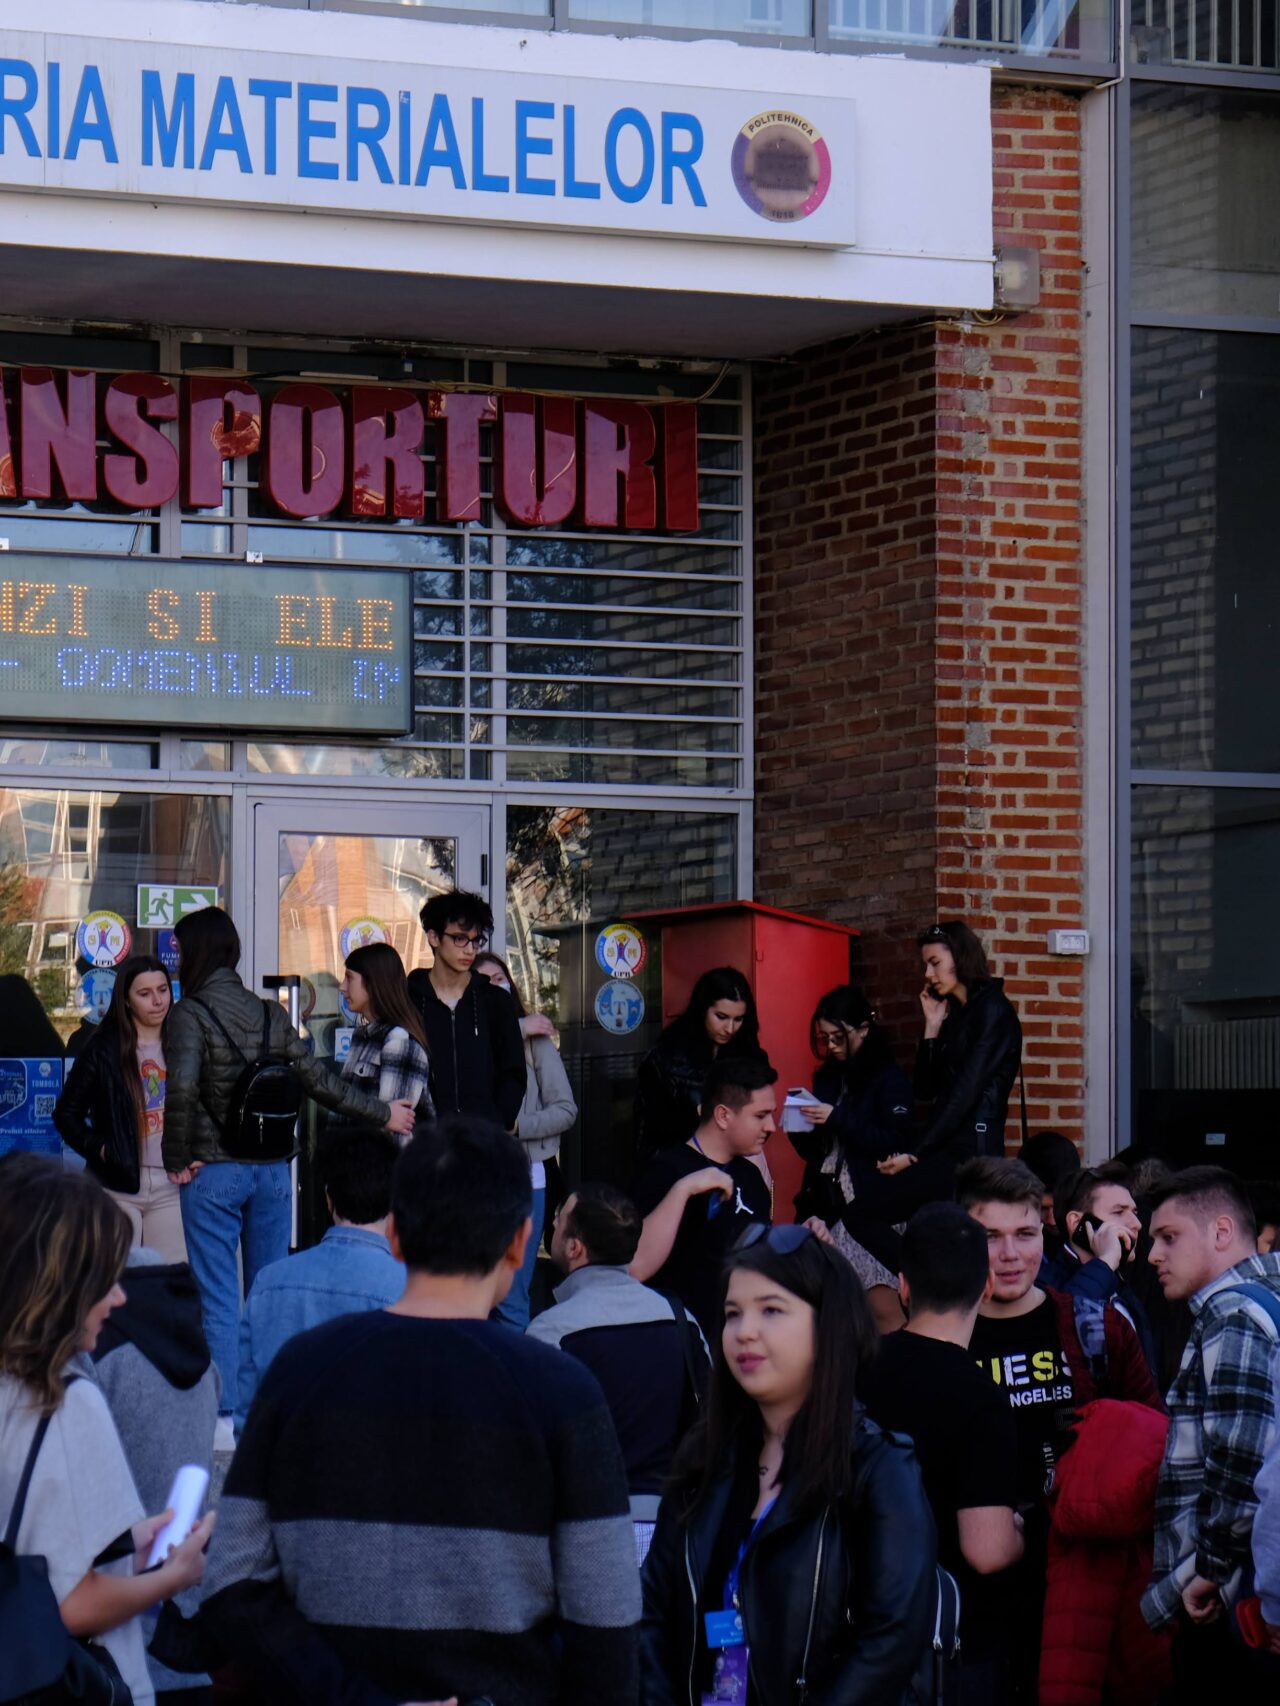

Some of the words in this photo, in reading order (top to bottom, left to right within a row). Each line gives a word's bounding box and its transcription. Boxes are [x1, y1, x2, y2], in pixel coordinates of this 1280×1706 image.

[142, 70, 707, 209] MATERIALELOR
[748, 113, 814, 137] POLITEHNICA
[147, 587, 217, 643] SI
[274, 594, 395, 650] ELE
[1009, 1384, 1073, 1409] NGELES
